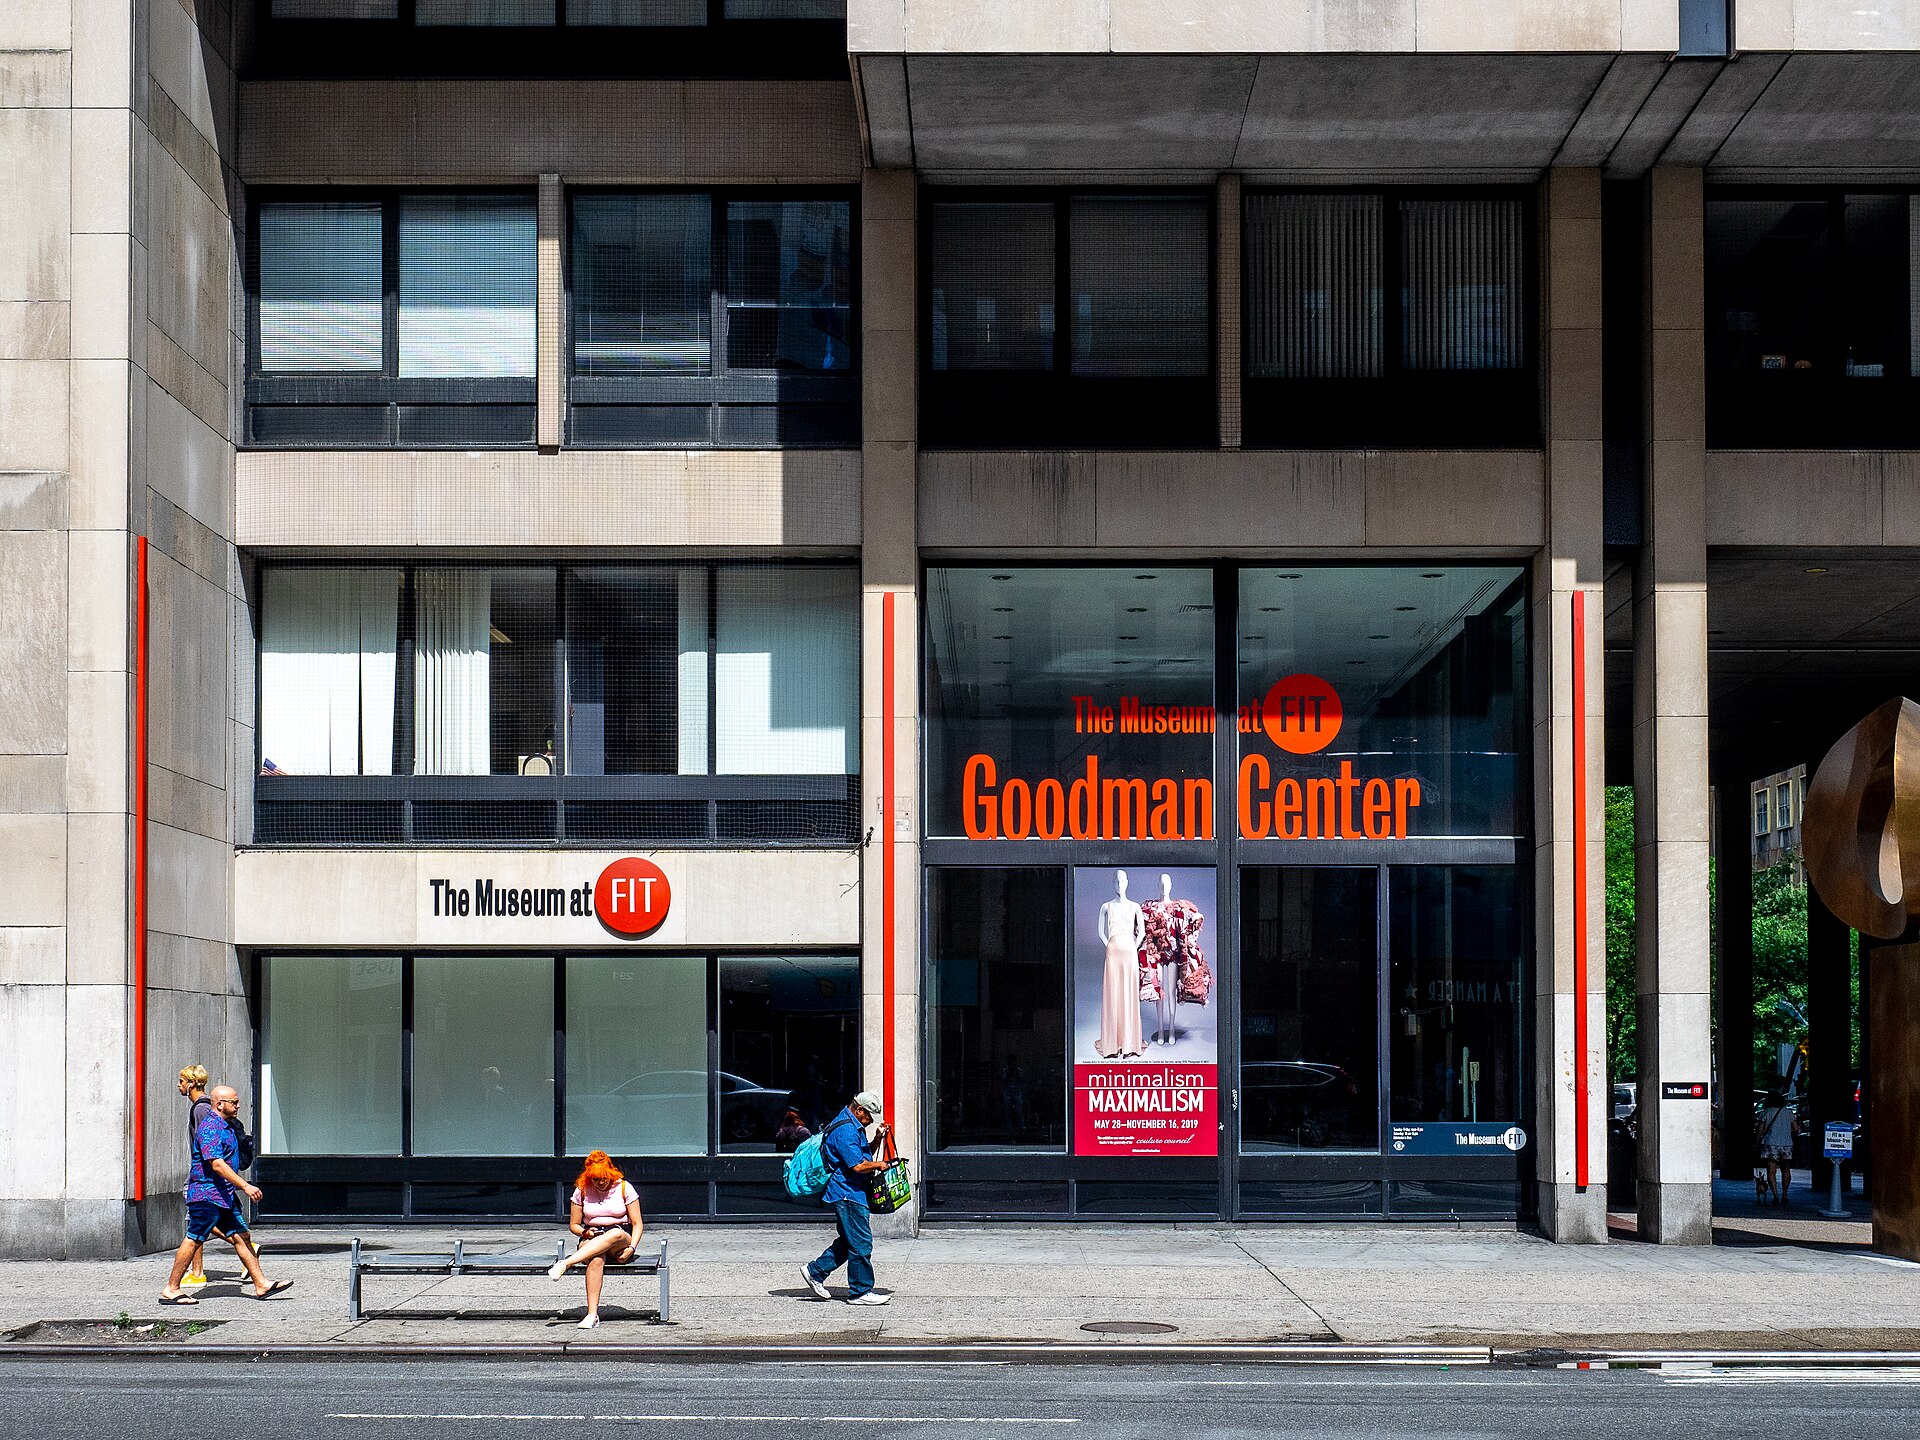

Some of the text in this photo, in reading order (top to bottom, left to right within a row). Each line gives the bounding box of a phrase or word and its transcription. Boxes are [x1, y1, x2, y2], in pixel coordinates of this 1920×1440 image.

[1071, 695, 1328, 734] The Museum at FIT
[962, 753, 1421, 840] Goodman Center
[430, 877, 657, 917] The Museum at FIT
[1088, 1067, 1204, 1087] minimalism
[1088, 1090, 1204, 1112] MAXIMALISM
[1094, 1119, 1110, 1129] MAY
[1169, 1119, 1179, 1130] 16,
[1181, 1119, 1199, 1129] 2019
[1455, 1133, 1522, 1145] The Museum at FIT
